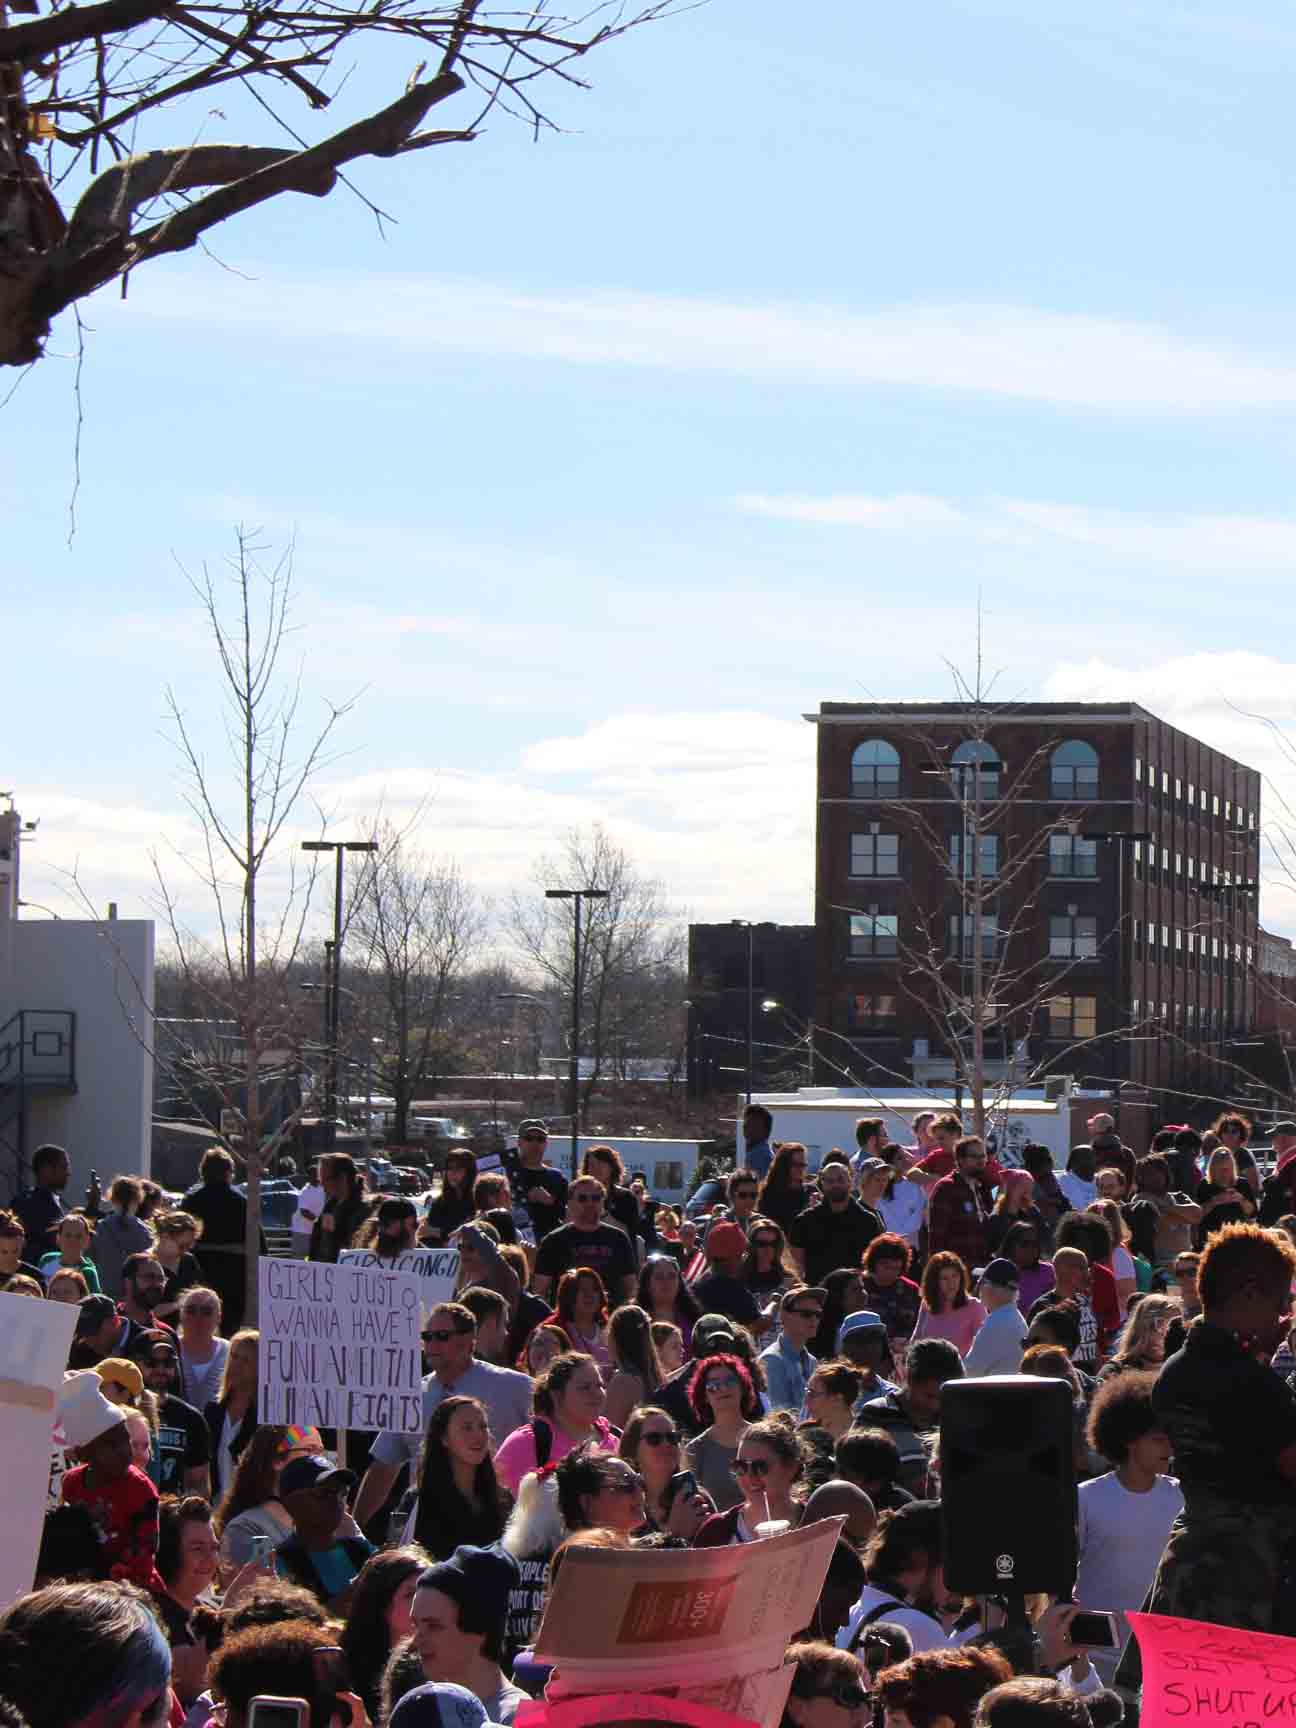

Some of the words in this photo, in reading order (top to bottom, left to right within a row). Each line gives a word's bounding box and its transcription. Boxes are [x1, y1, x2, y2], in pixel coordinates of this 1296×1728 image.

[268, 1261, 334, 1303] GIRLS
[351, 1271, 399, 1308] JUST
[271, 1305, 342, 1341] WANNA
[352, 1309, 400, 1344] HAVE
[1163, 1682, 1255, 1716] SHUT
